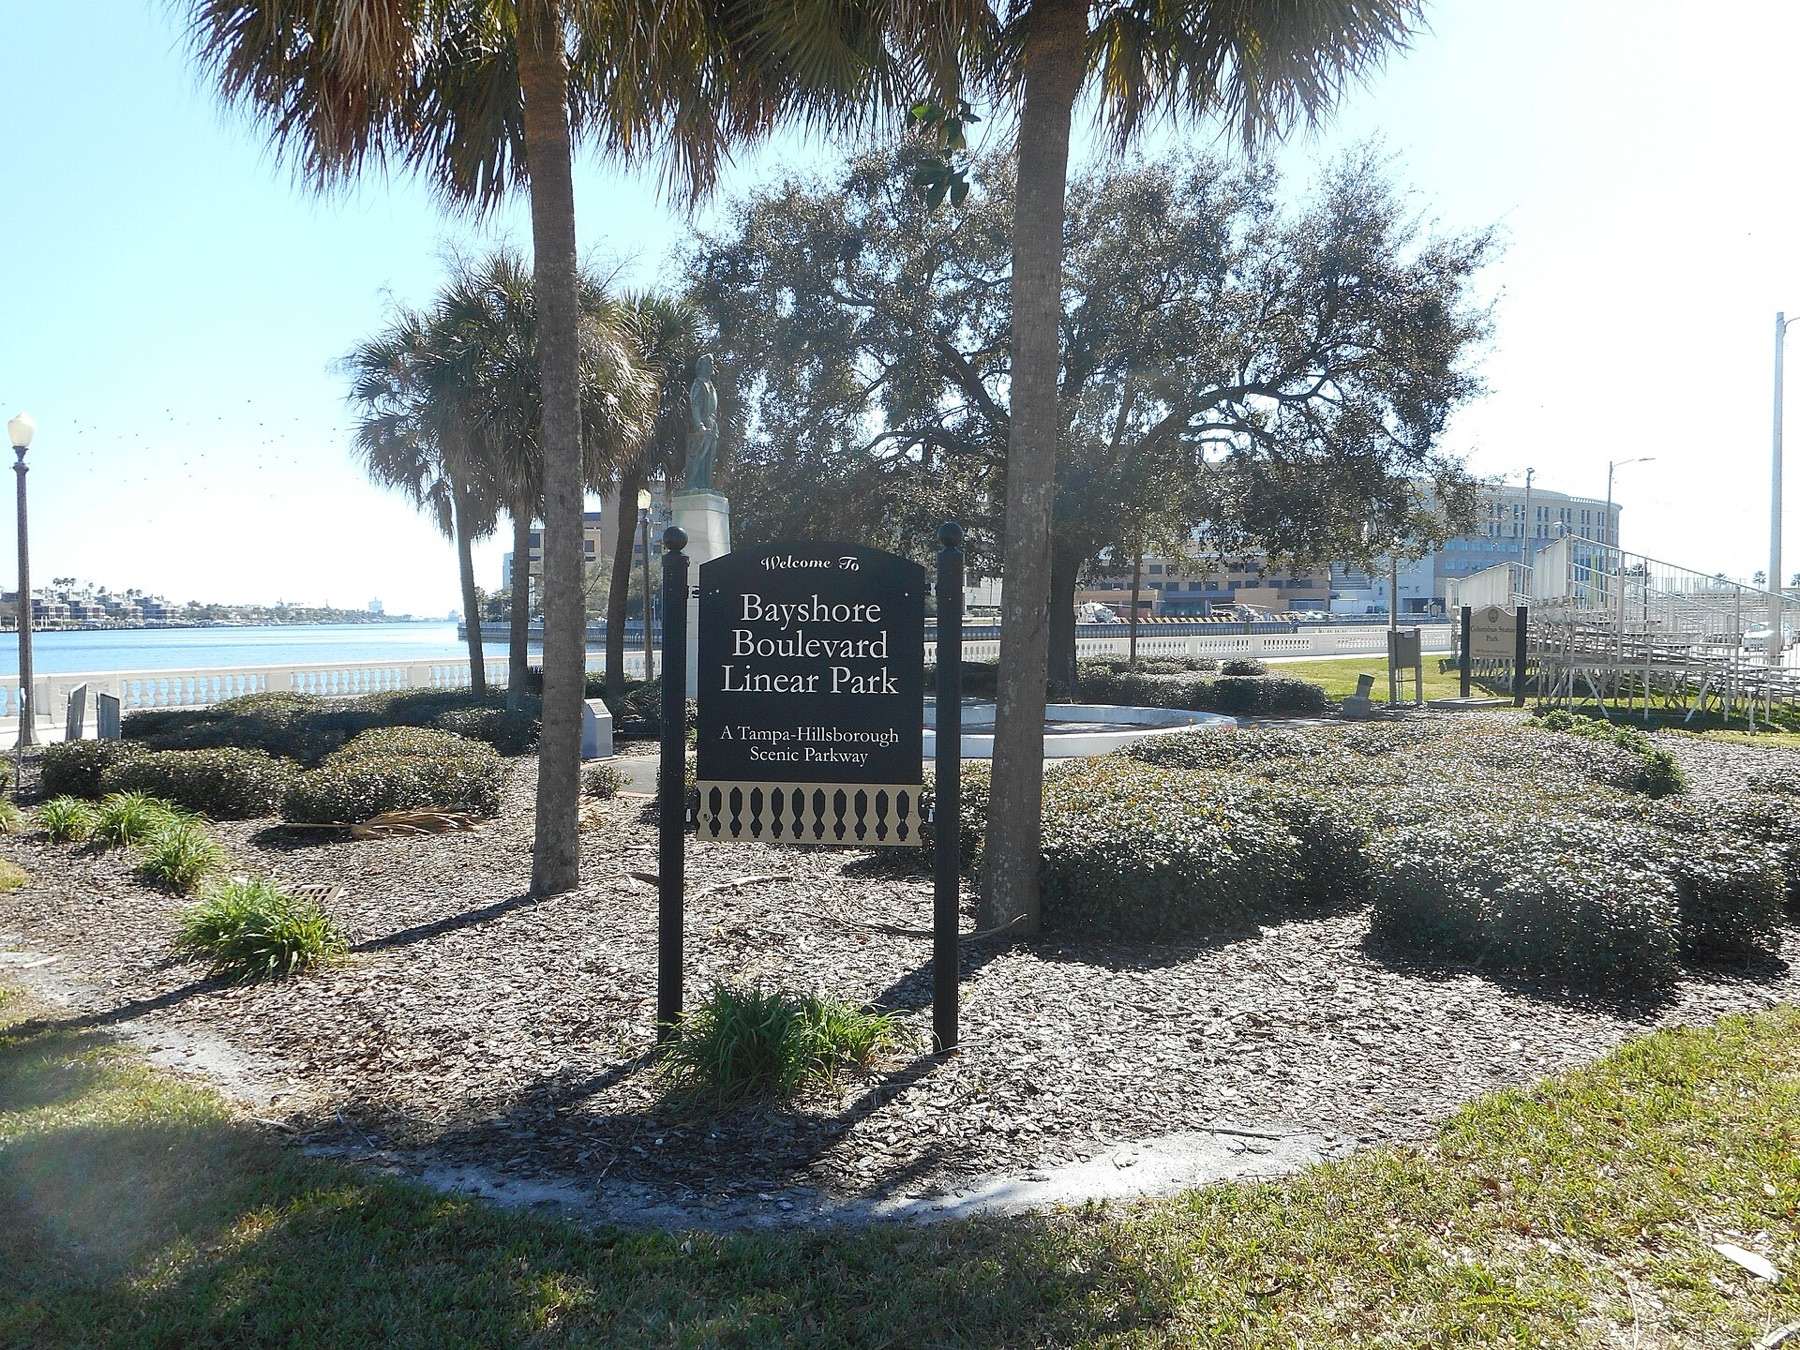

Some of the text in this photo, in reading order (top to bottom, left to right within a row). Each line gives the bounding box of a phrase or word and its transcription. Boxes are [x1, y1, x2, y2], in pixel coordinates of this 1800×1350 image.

[760, 554, 860, 572] Welcome To
[740, 593, 881, 631] Bayshore
[732, 629, 889, 659] Boulevard
[721, 665, 899, 694] Linear Park
[719, 725, 899, 747] A Tampa-Hillsborough
[750, 746, 868, 767] Scenic Parkway
